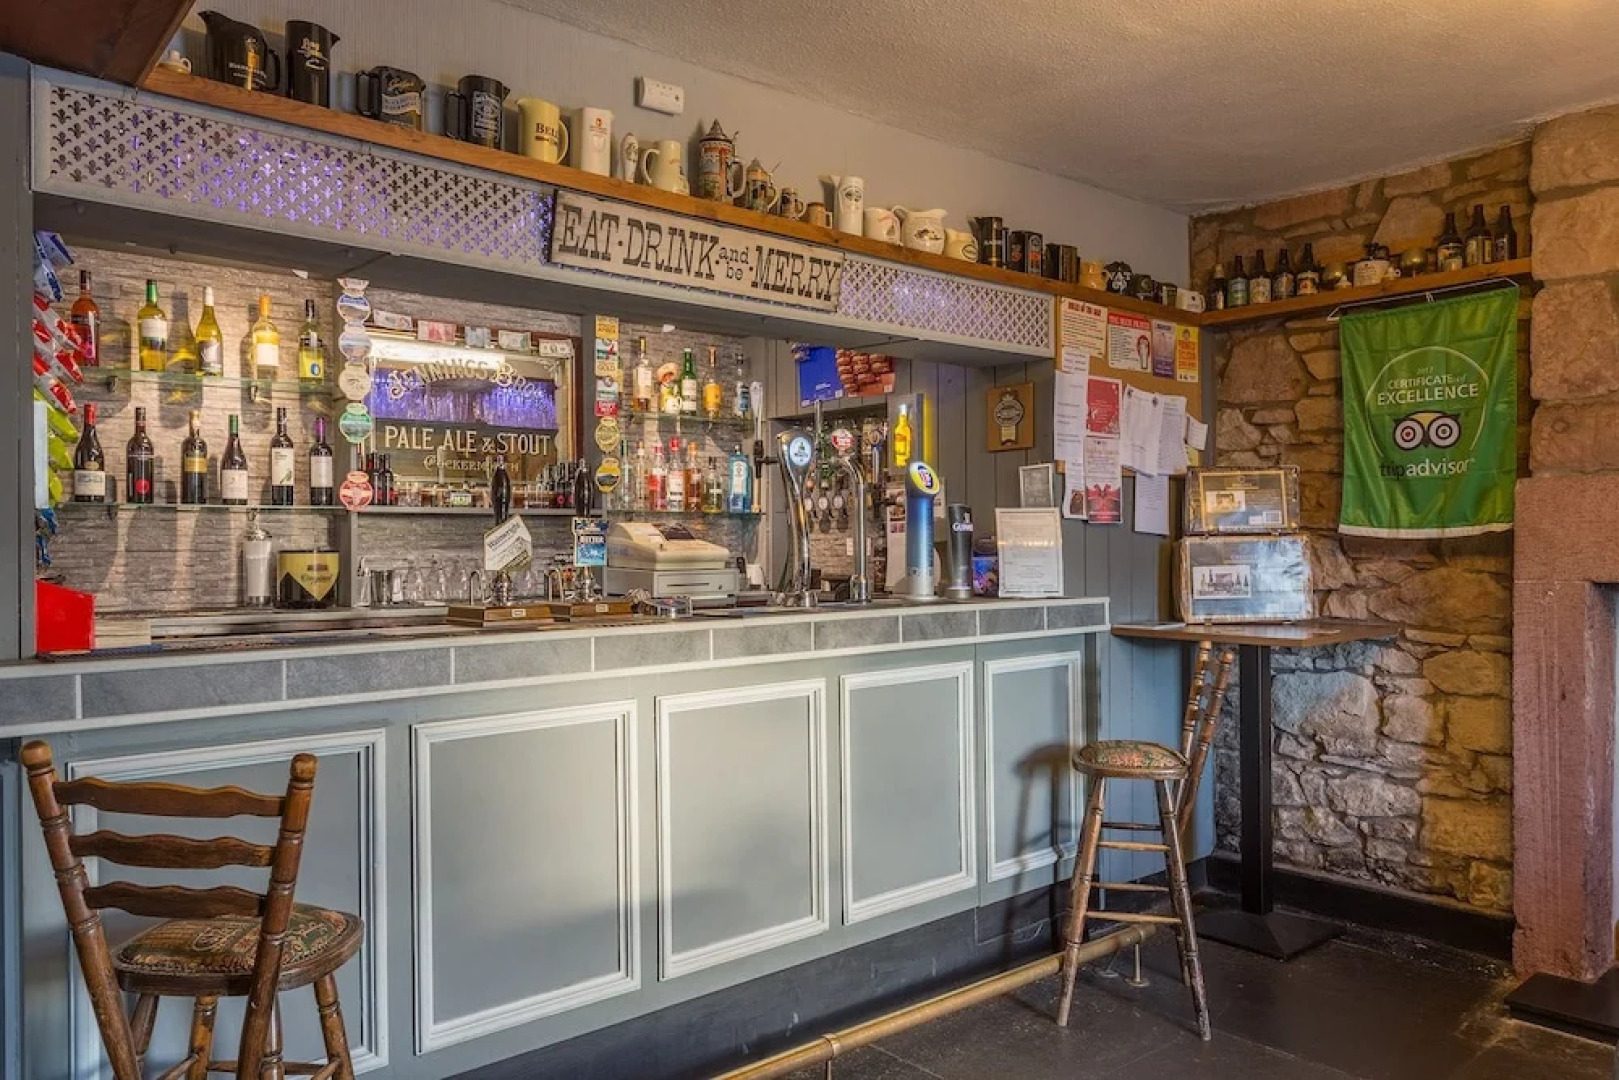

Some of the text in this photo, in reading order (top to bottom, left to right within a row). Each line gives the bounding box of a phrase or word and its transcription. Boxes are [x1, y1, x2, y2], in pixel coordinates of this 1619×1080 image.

[559, 204, 842, 300] EAT DRINK and be MERRY
[1388, 375, 1452, 388] CERTIFICATE
[1377, 384, 1479, 405] EXCELLENCE
[385, 425, 551, 456] PALE ALE & STOUT
[1380, 457, 1470, 481] tripadvisor
